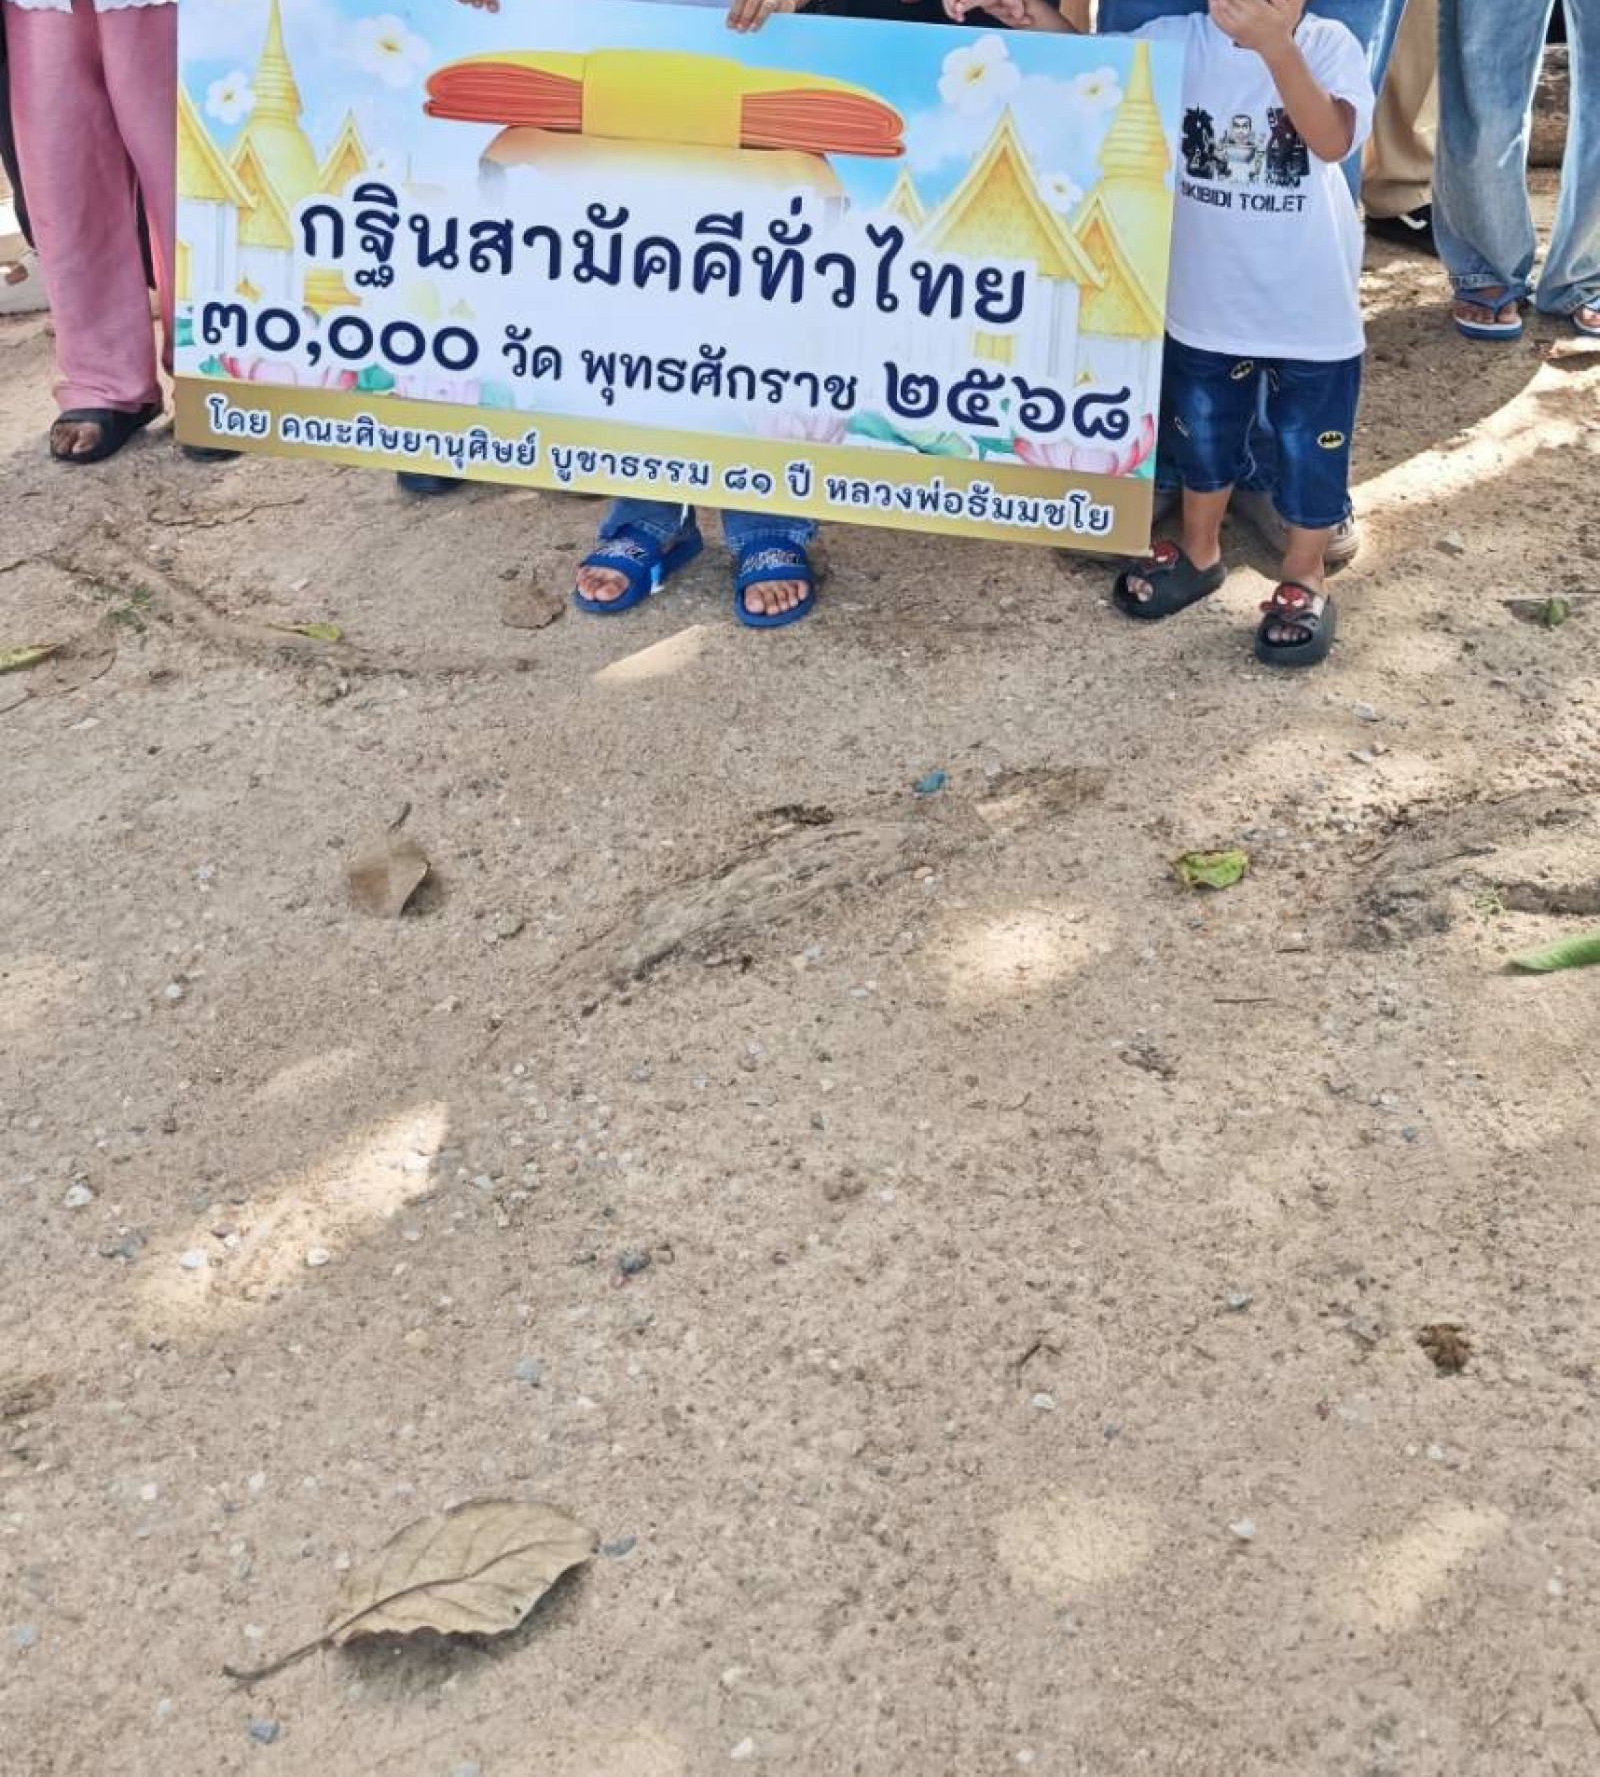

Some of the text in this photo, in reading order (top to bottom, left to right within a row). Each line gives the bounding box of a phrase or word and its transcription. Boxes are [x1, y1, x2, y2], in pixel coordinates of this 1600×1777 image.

[299, 181, 1026, 324] กฐินสามัคคีทั่วไทย
[1239, 193, 1307, 212] TOILET
[202, 301, 1131, 443] ๓๐,๐๐๐ วัด พุทธศักราช ๒๕๖๘
[208, 398, 1109, 531] โดย คณะศิษยานุศิษย์ บูชาธรรม ๘๑ ปี หลวงพ่อธัมมชโย
